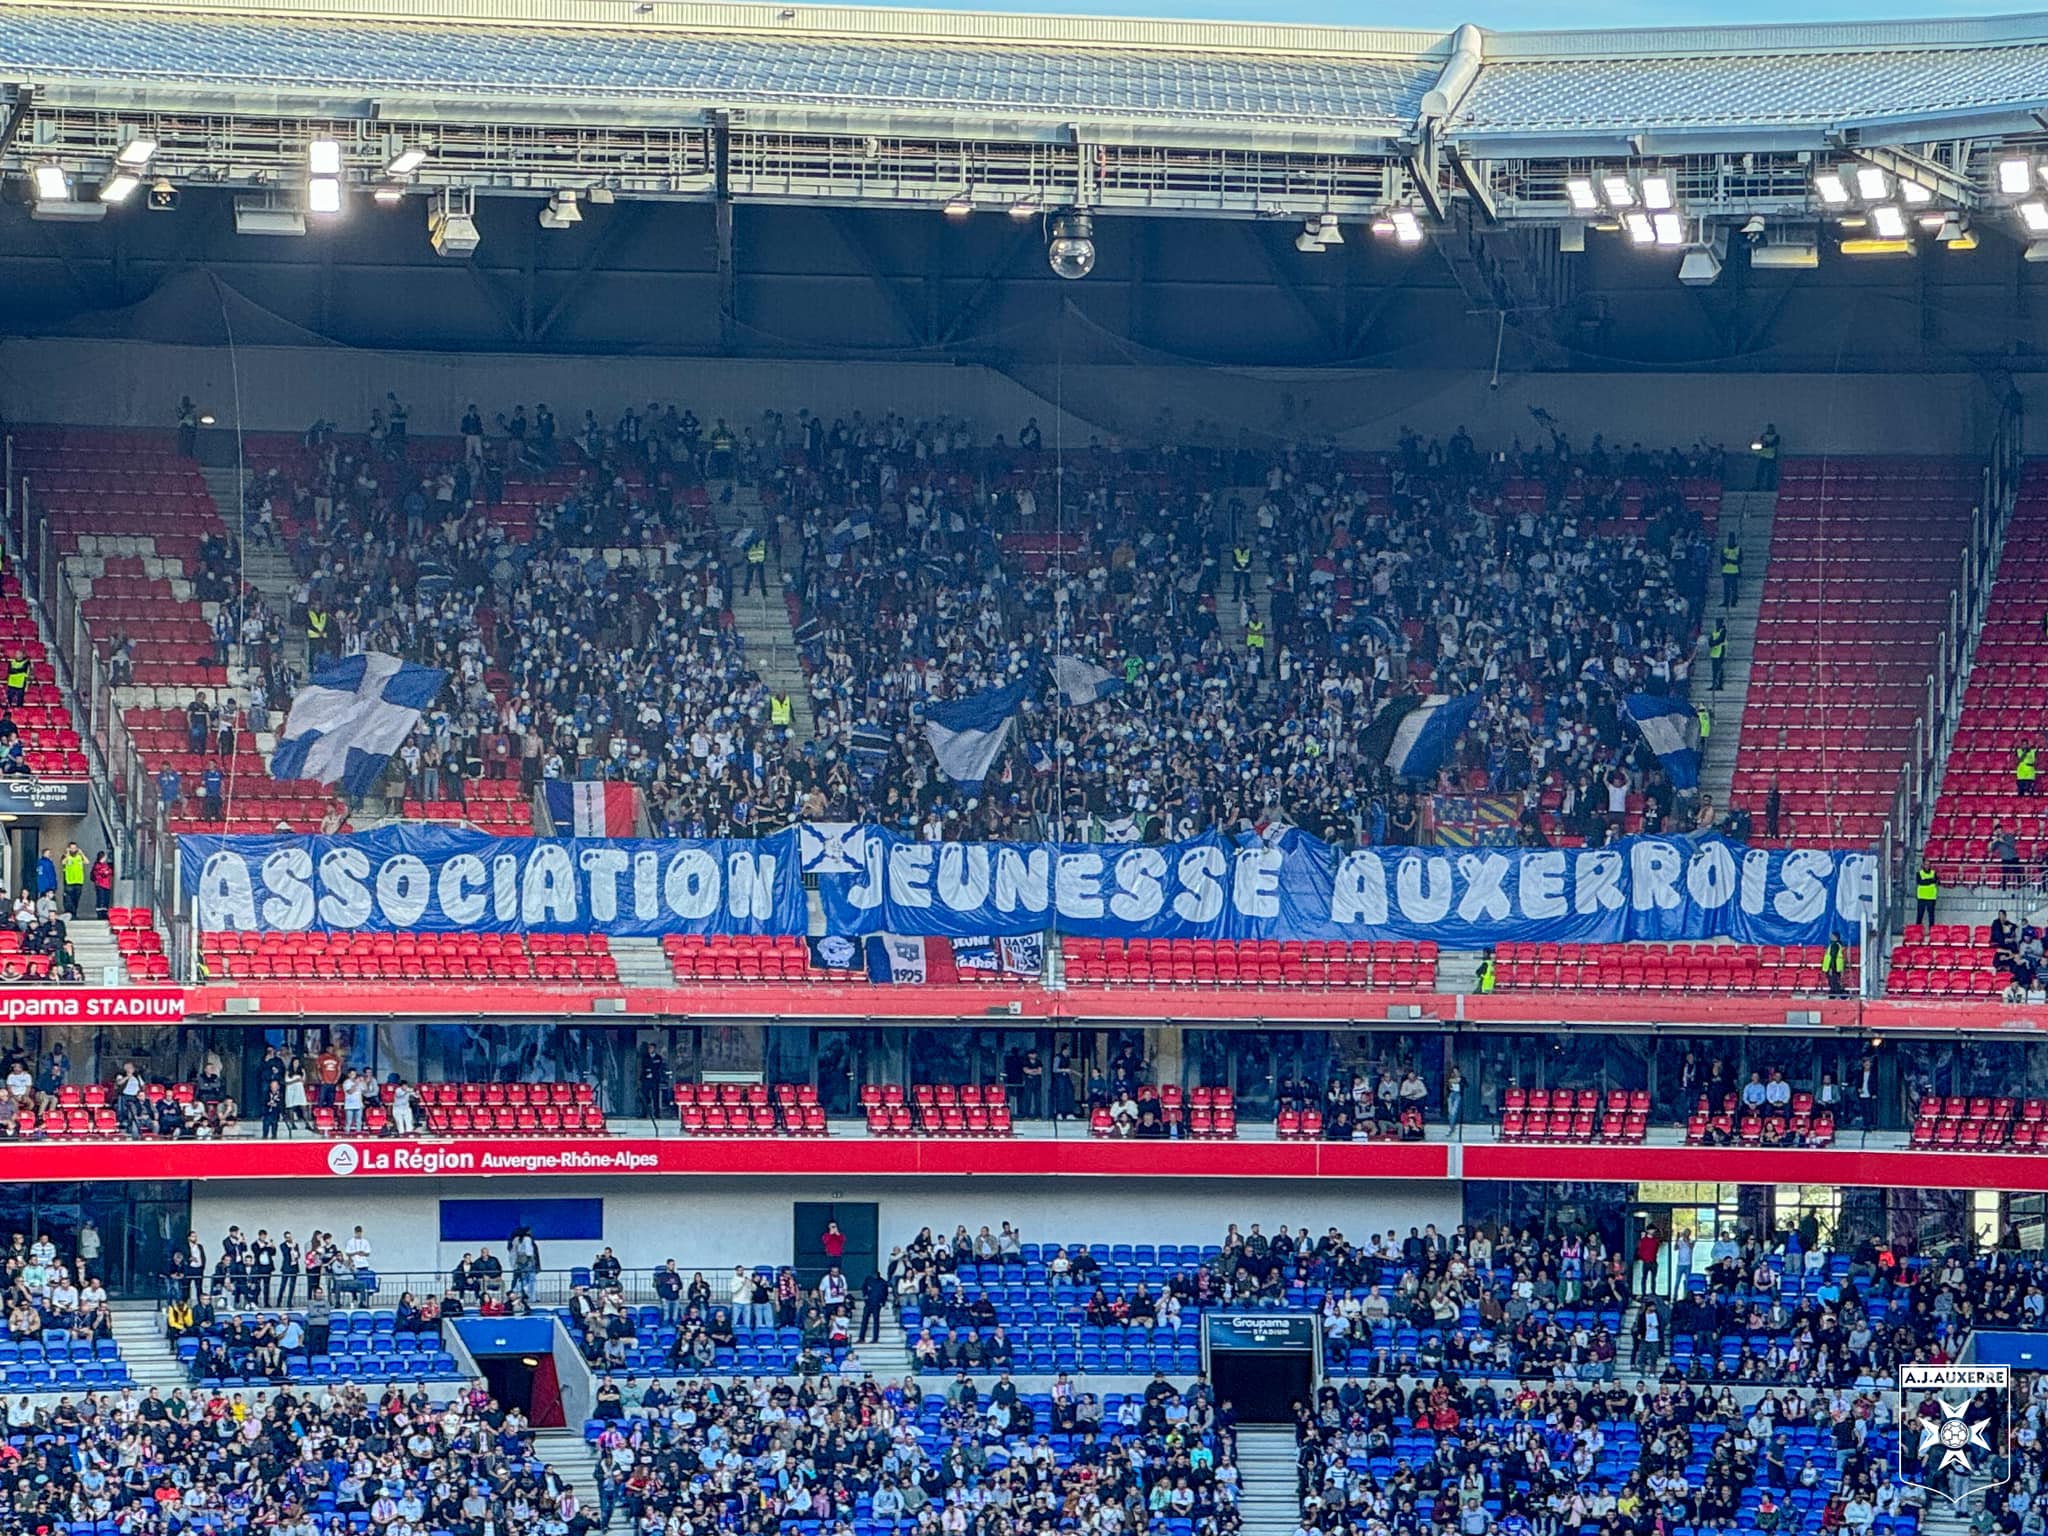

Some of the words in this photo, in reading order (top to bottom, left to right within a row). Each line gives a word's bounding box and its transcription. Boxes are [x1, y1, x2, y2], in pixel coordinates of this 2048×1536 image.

[200, 845, 776, 931] ASSOCIATION
[848, 837, 1283, 923] JEUNESSE
[1331, 840, 1877, 925] AUXERROISE
[952, 936, 990, 949] JEUNE
[86, 998, 185, 1016] STADIUM
[362, 1149, 389, 1169] La
[394, 1148, 474, 1172] Région
[481, 1151, 658, 1171] Auvergne-Rhône-Alpes
[1232, 1317, 1290, 1329] Groupama
